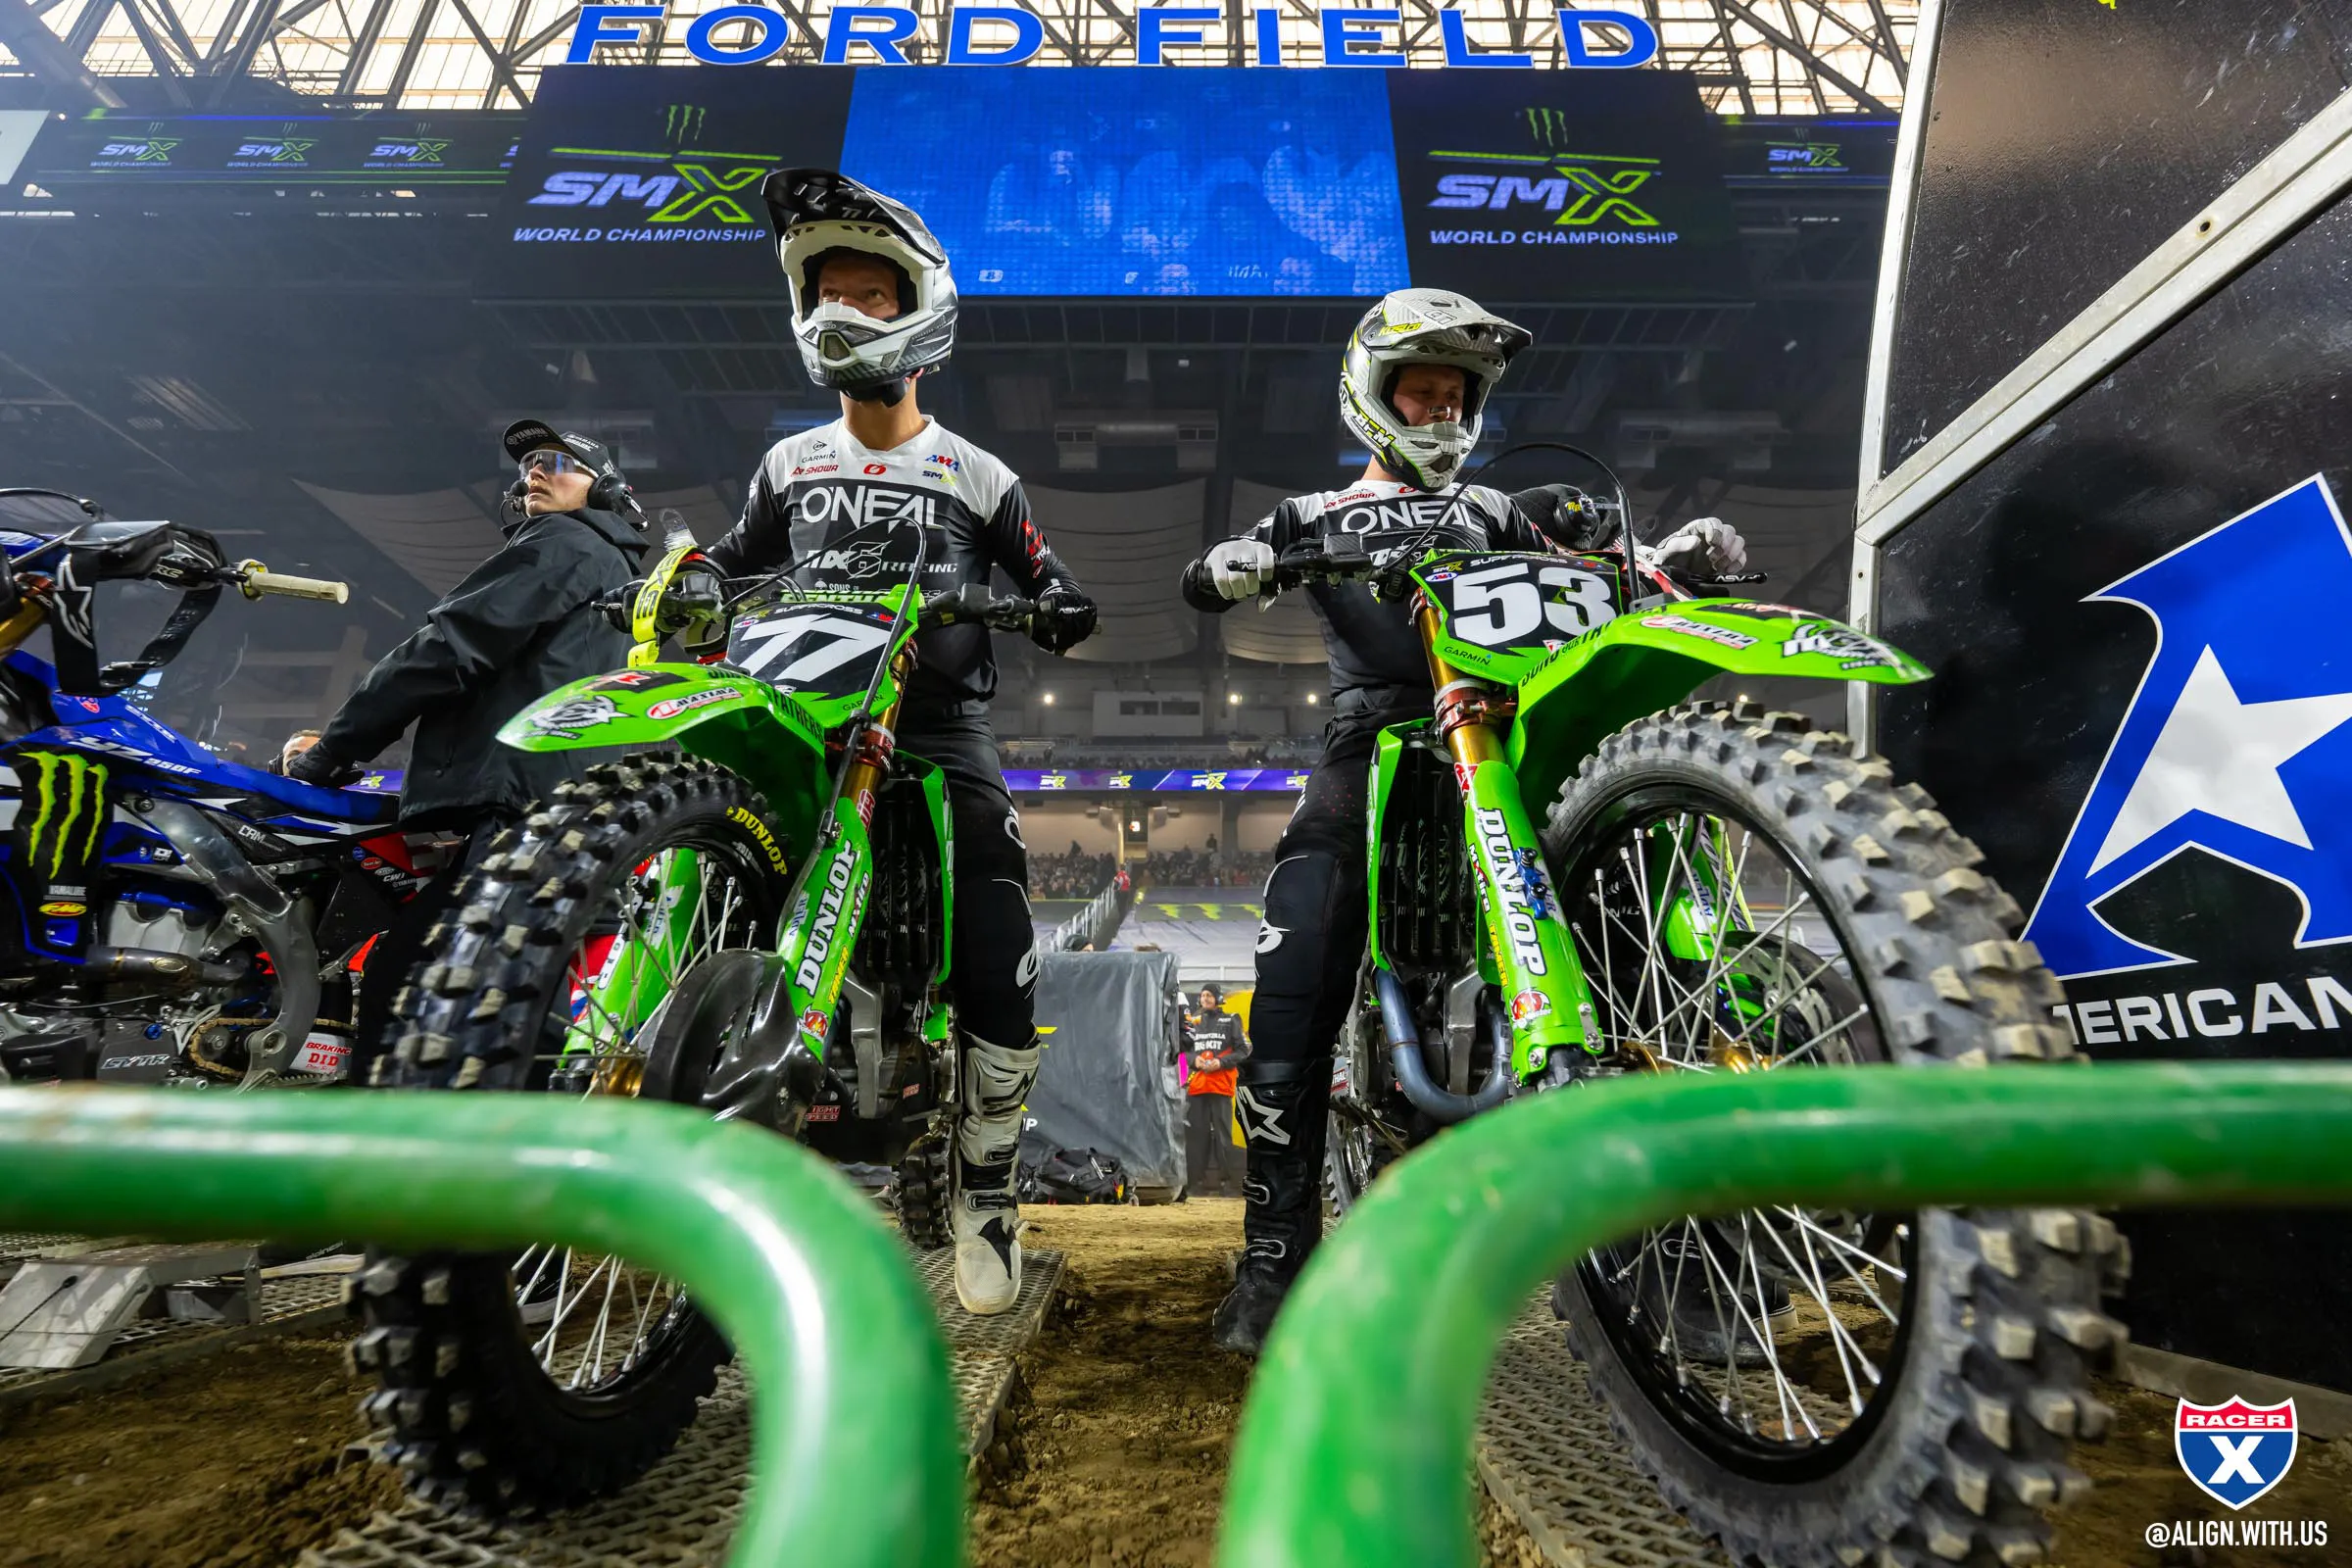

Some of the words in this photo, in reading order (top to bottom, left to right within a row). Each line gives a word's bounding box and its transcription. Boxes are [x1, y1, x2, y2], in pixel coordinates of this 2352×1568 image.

[564, 5, 1046, 66] FORD
[1137, 7, 1660, 69] FIELD
[98, 141, 177, 161] SMX
[233, 141, 313, 161] SMX
[369, 142, 448, 162] SMX
[1768, 147, 1841, 167] SMX
[526, 163, 767, 224] SMX
[1428, 166, 1661, 226] SMX
[514, 227, 602, 242] WORLD
[606, 228, 766, 242] CHAMPIONSHIP
[1430, 230, 1516, 244] WORLD
[1521, 231, 1679, 244] CHAMPIONSHIP
[802, 453, 836, 464] GARMIN
[925, 454, 959, 471] AMA
[805, 465, 839, 475] SHOWA
[1338, 493, 1376, 504] SHOWA
[1432, 561, 1463, 573] SMX
[1453, 563, 1618, 647] 53
[1674, 620, 1757, 649] MAXIMA
[740, 612, 893, 683] 77
[1444, 646, 1491, 666] GARMIN
[676, 687, 738, 708] MAXIMA
[144, 758, 202, 775] 250F
[732, 807, 788, 875] DUNLOP
[1479, 808, 1546, 975] DUNLOP
[306, 1042, 352, 1055] BRAKING
